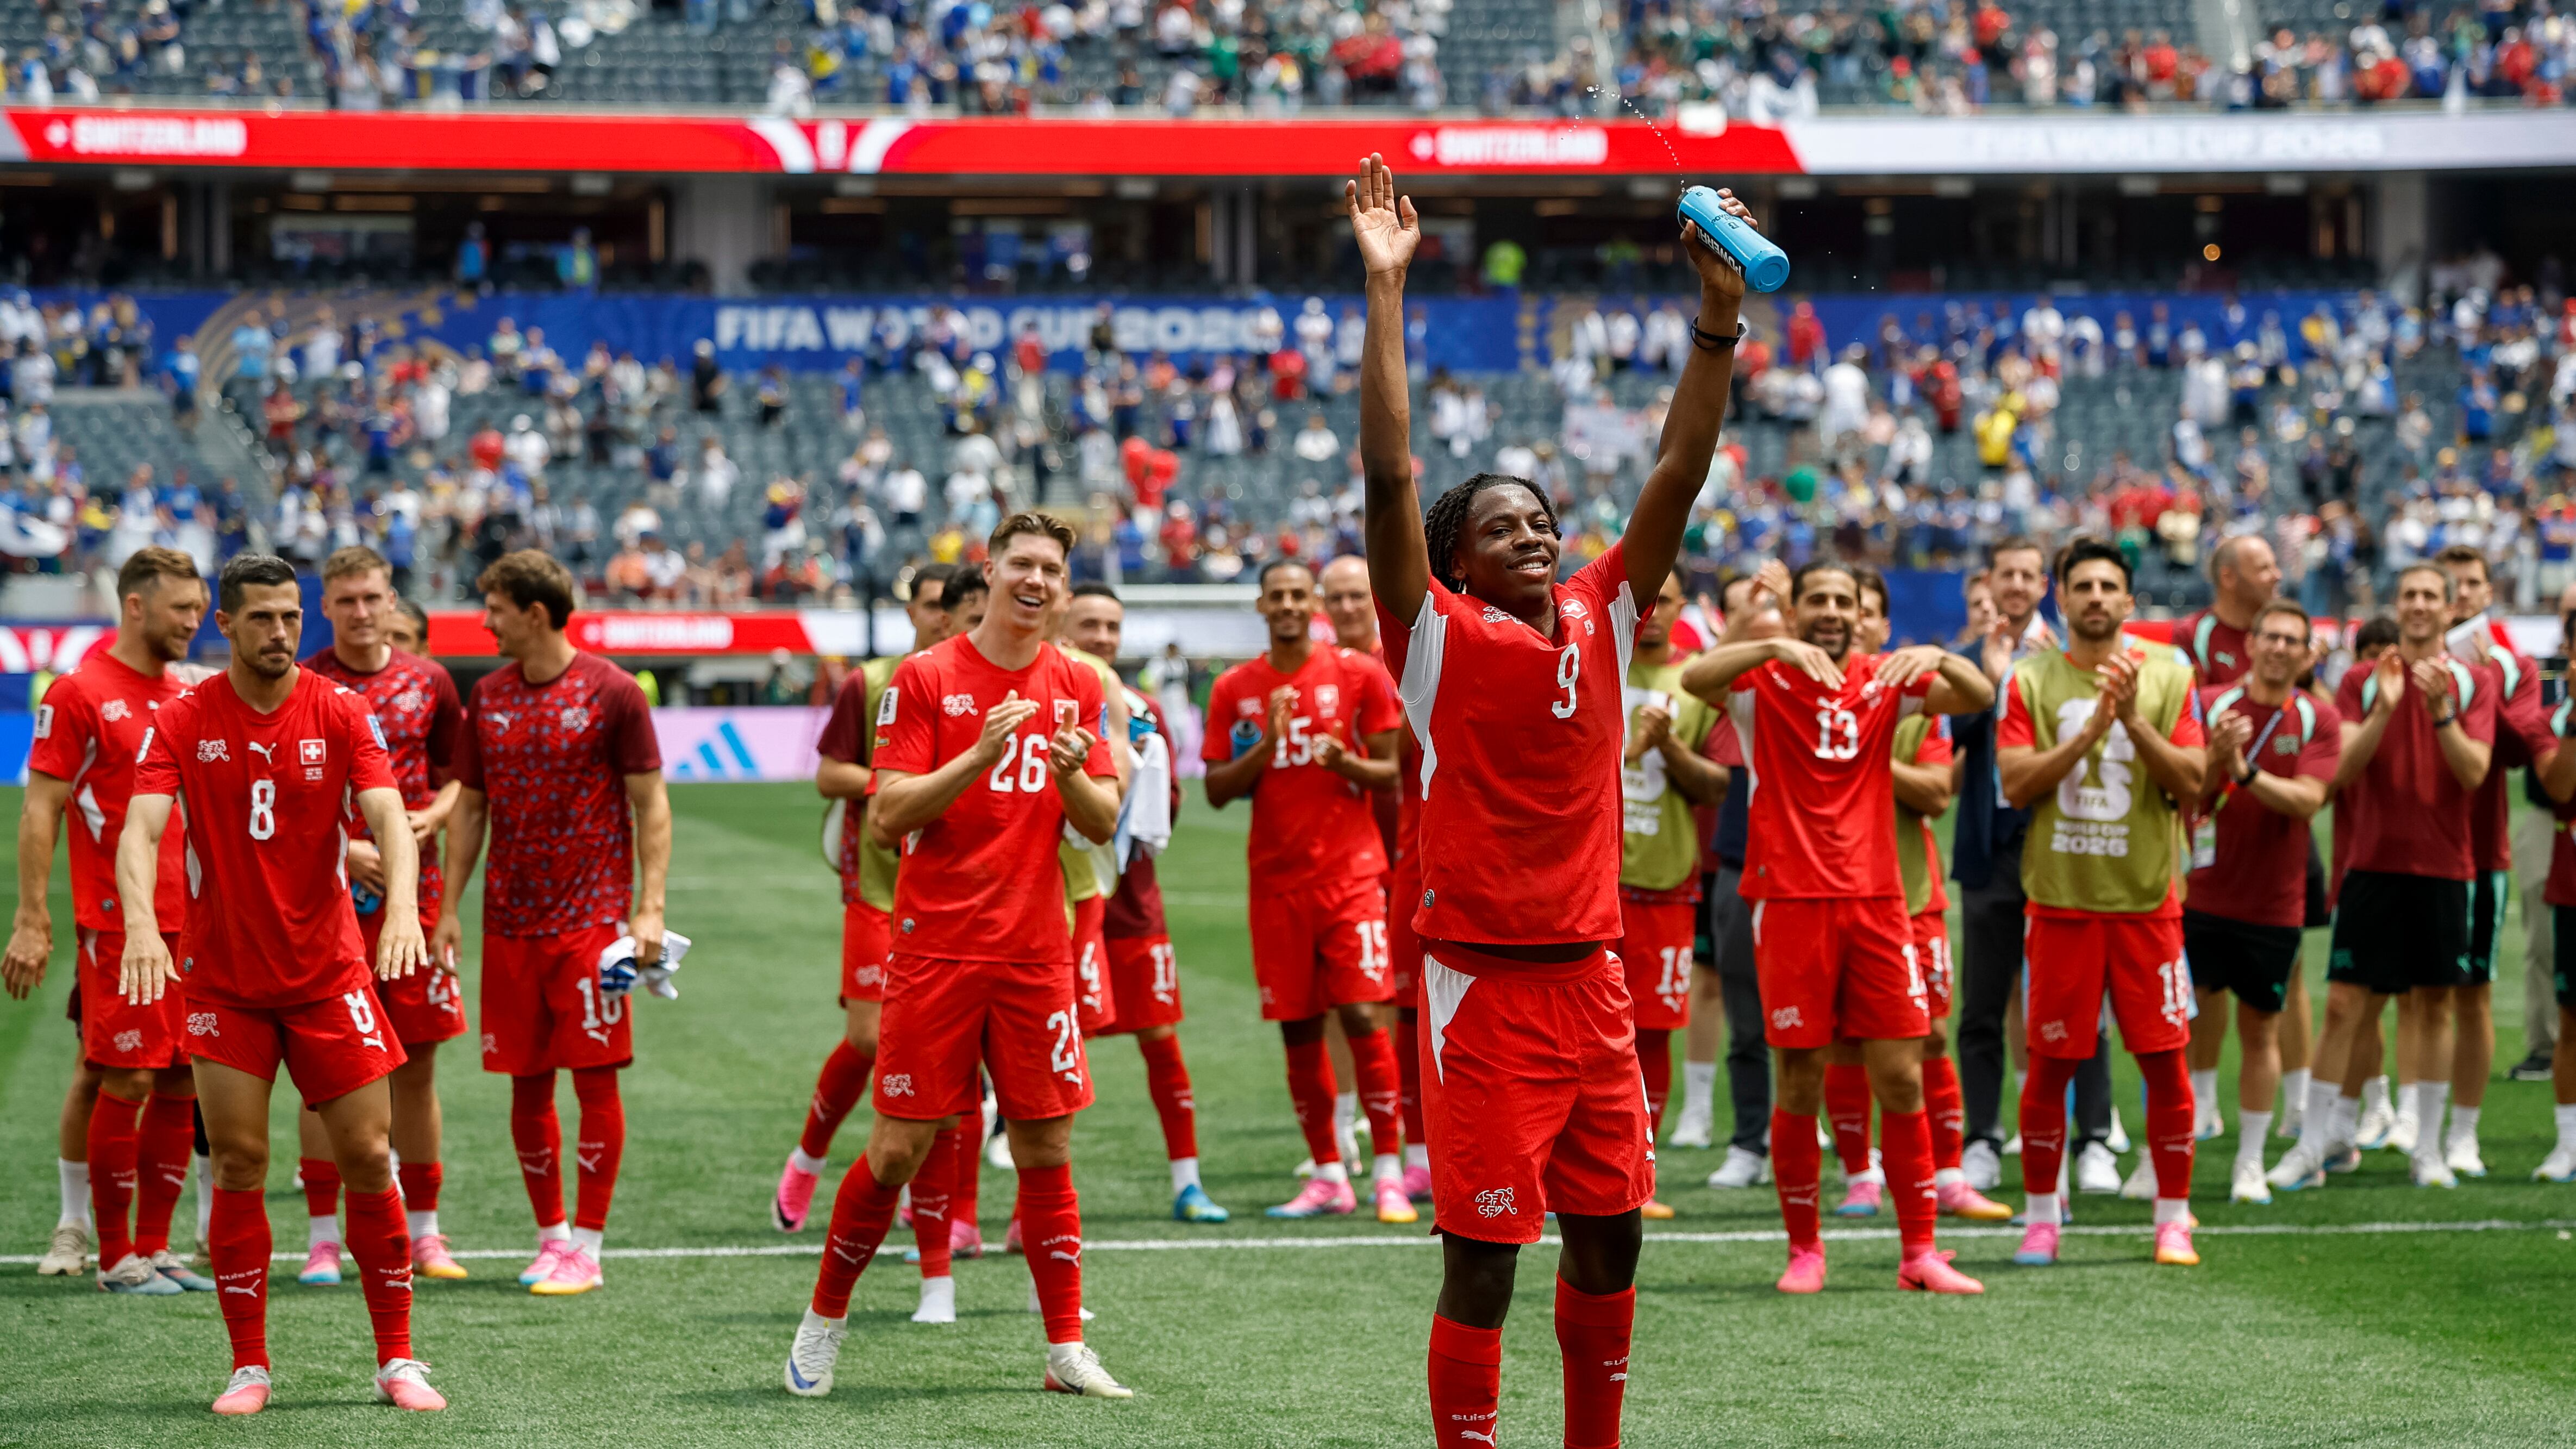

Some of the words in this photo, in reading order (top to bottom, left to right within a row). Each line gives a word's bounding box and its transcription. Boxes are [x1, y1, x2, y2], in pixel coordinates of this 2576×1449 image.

[71, 116, 247, 156] SWITZERLAND
[1434, 125, 1609, 165] SWITZERLAND
[1686, 218, 1742, 278] POWERA
[715, 306, 826, 351] FIFA
[826, 306, 1004, 351] WOD
[1552, 642, 1580, 719] 9
[1272, 716, 1313, 769] 15
[1815, 709, 1859, 759] 13
[990, 732, 1048, 793] 26
[249, 779, 276, 840] 8
[2074, 795, 2109, 808] FIFA
[2050, 833, 2129, 858] 2026
[2054, 820, 2099, 835] WORLD
[2100, 823, 2130, 837] CUP
[1654, 946, 1693, 995] 19
[1901, 943, 1928, 997] 1
[343, 988, 375, 1034] 8
[1603, 1354, 1629, 1366] suis
[1452, 1410, 1497, 1421] suisse
